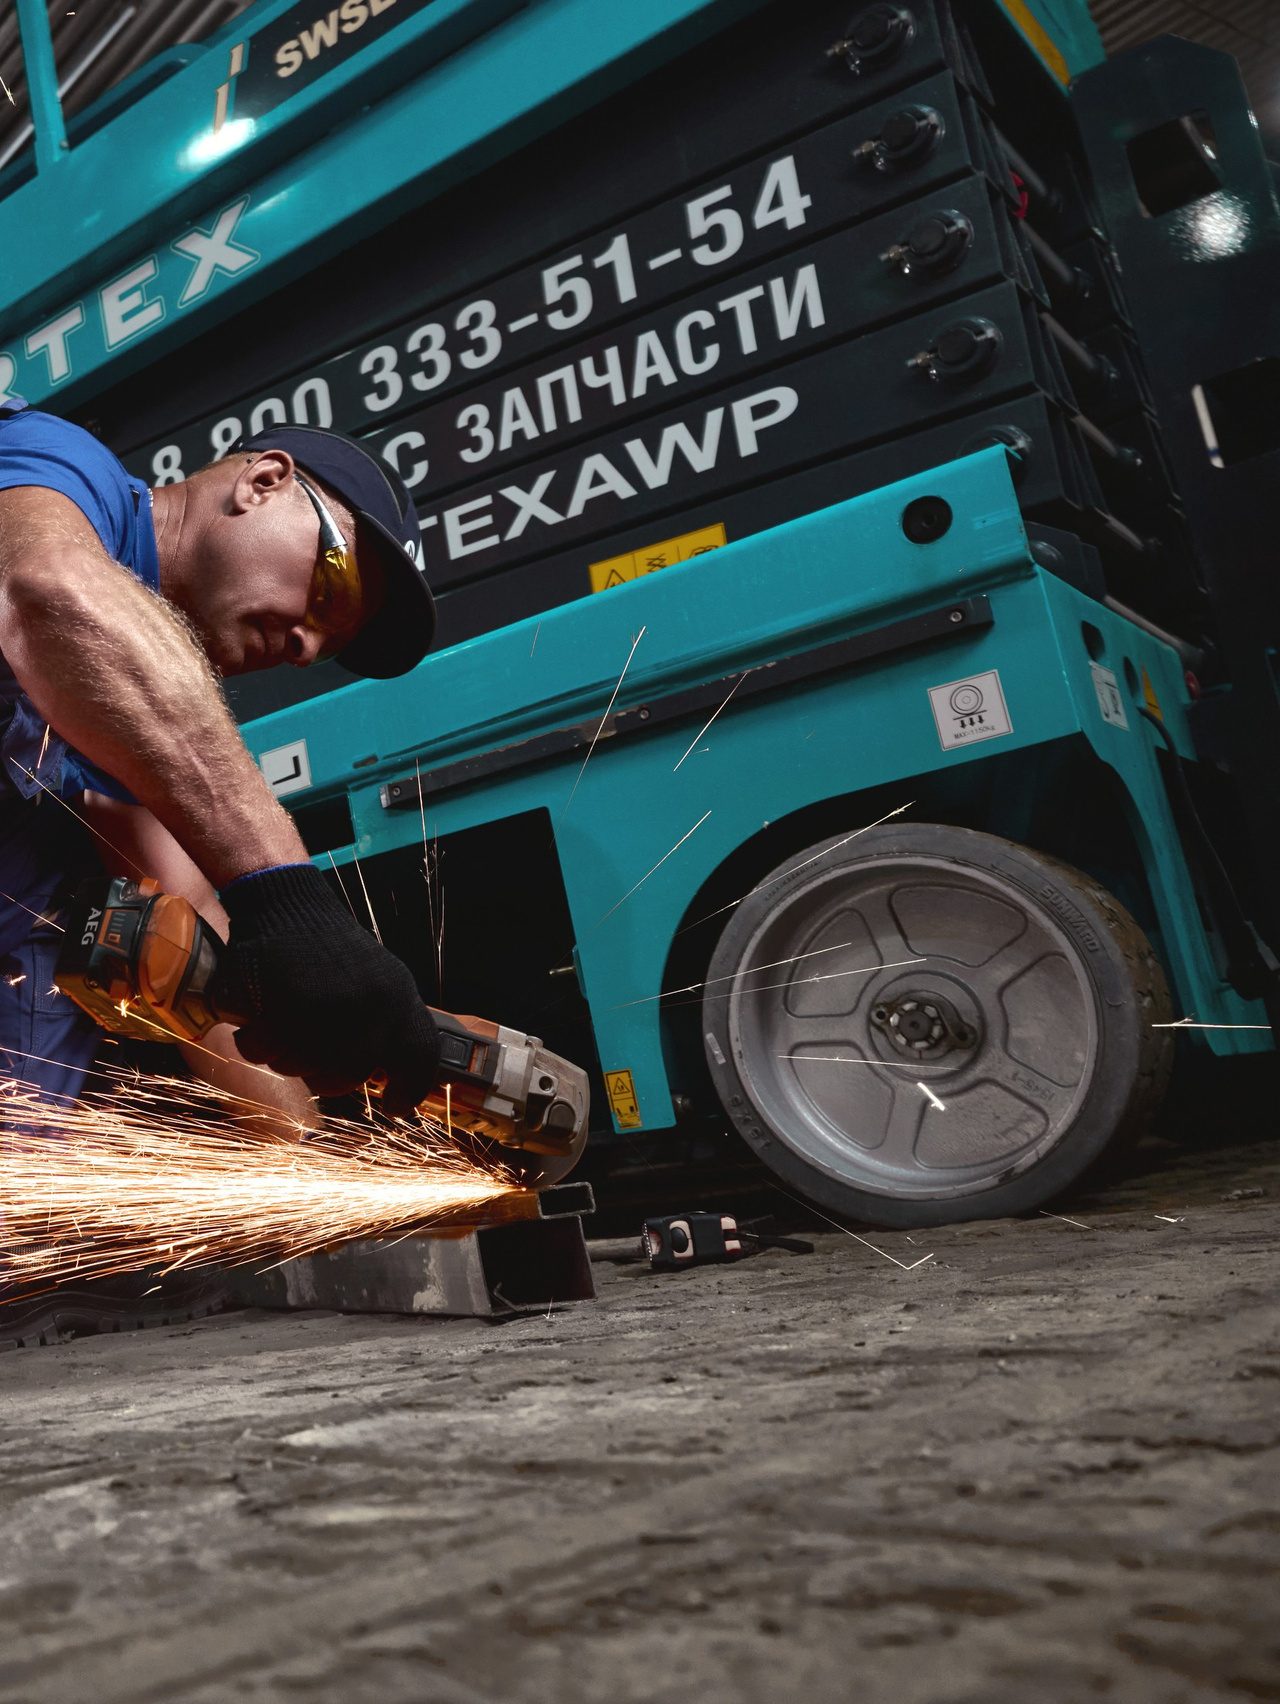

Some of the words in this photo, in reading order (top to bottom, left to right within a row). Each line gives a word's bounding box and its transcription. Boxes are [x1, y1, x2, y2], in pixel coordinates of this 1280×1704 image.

[360, 155, 812, 412] 333-51-54
[457, 264, 826, 463] ЗАПЧАСТИ
[81, 907, 102, 945] AEG
[1040, 885, 1100, 953] SUNWARD
